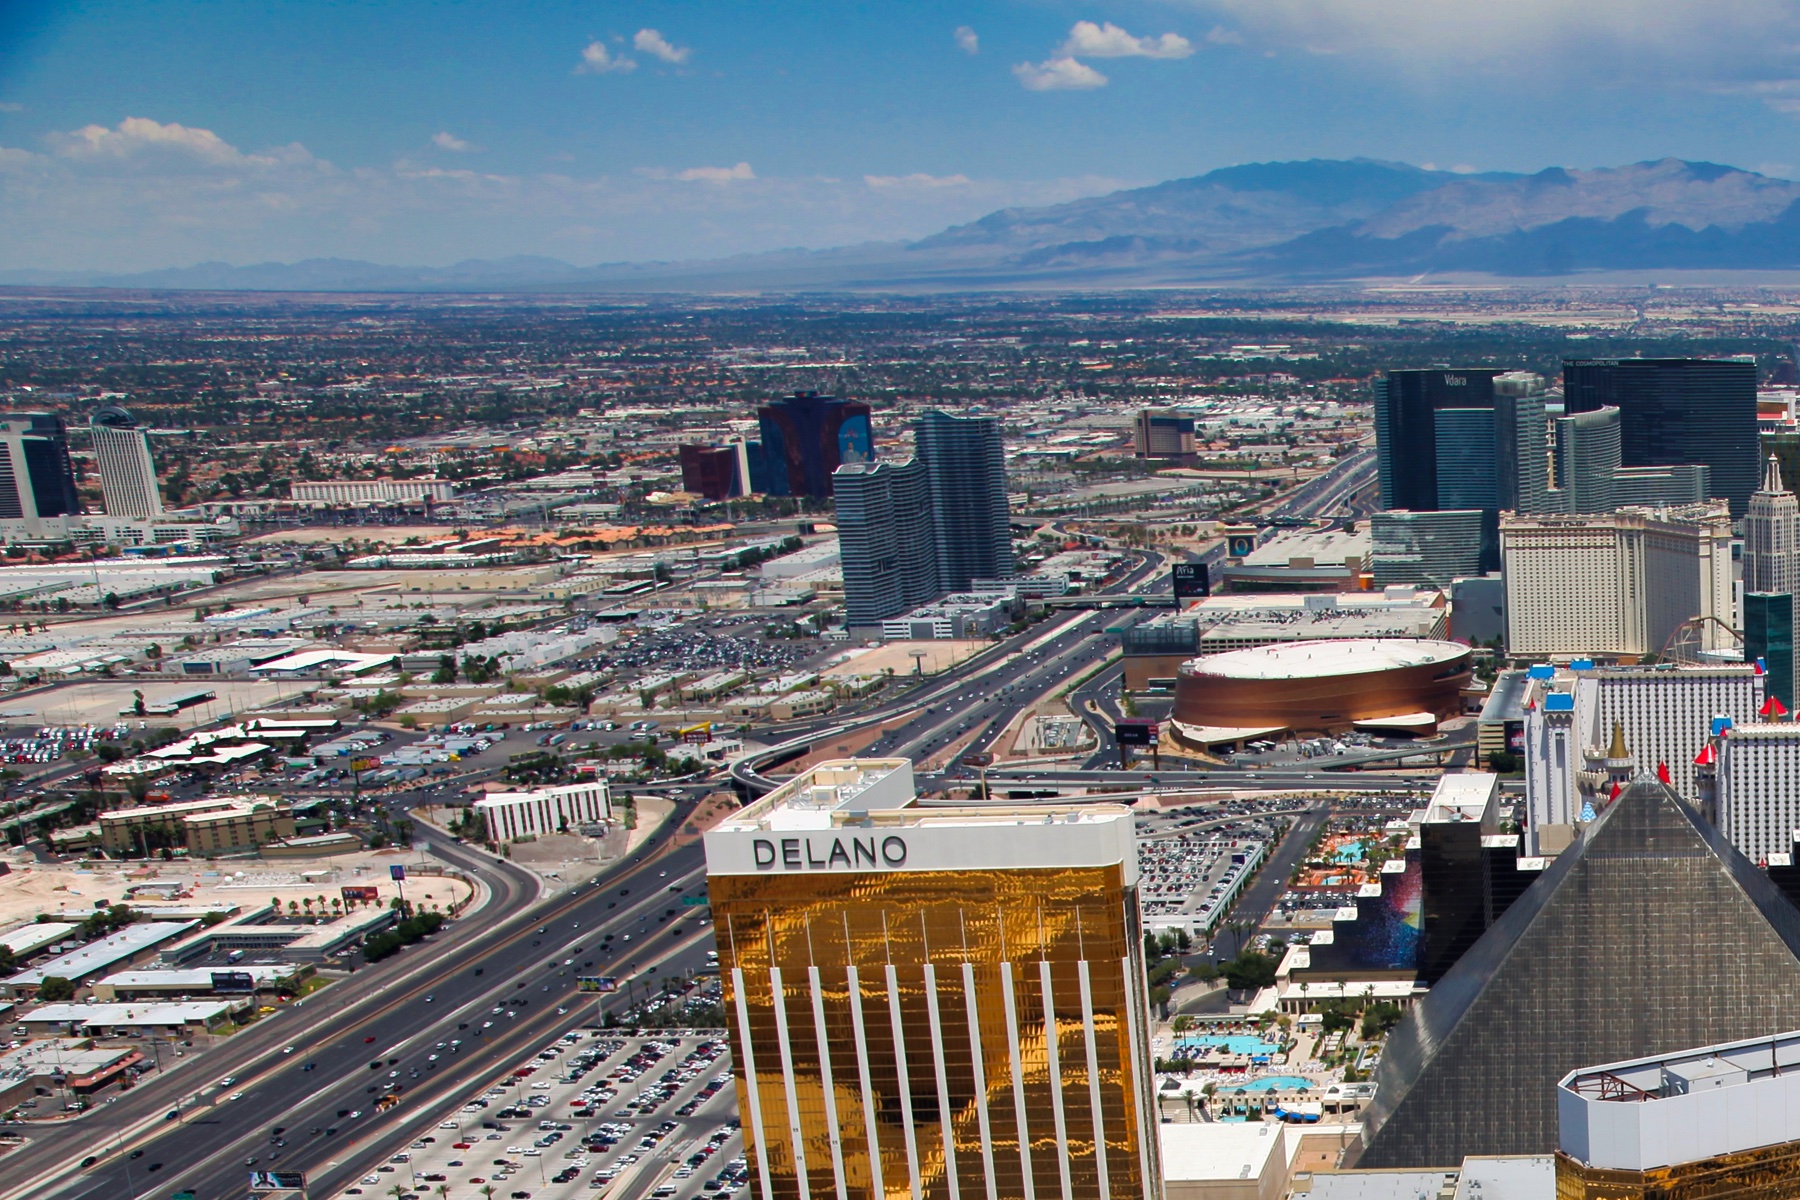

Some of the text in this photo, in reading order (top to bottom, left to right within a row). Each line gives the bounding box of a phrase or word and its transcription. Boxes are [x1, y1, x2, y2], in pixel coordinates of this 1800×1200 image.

[1444, 374, 1467, 386] Vdara
[1176, 565, 1195, 575] Aria
[753, 835, 907, 866] DELANO
